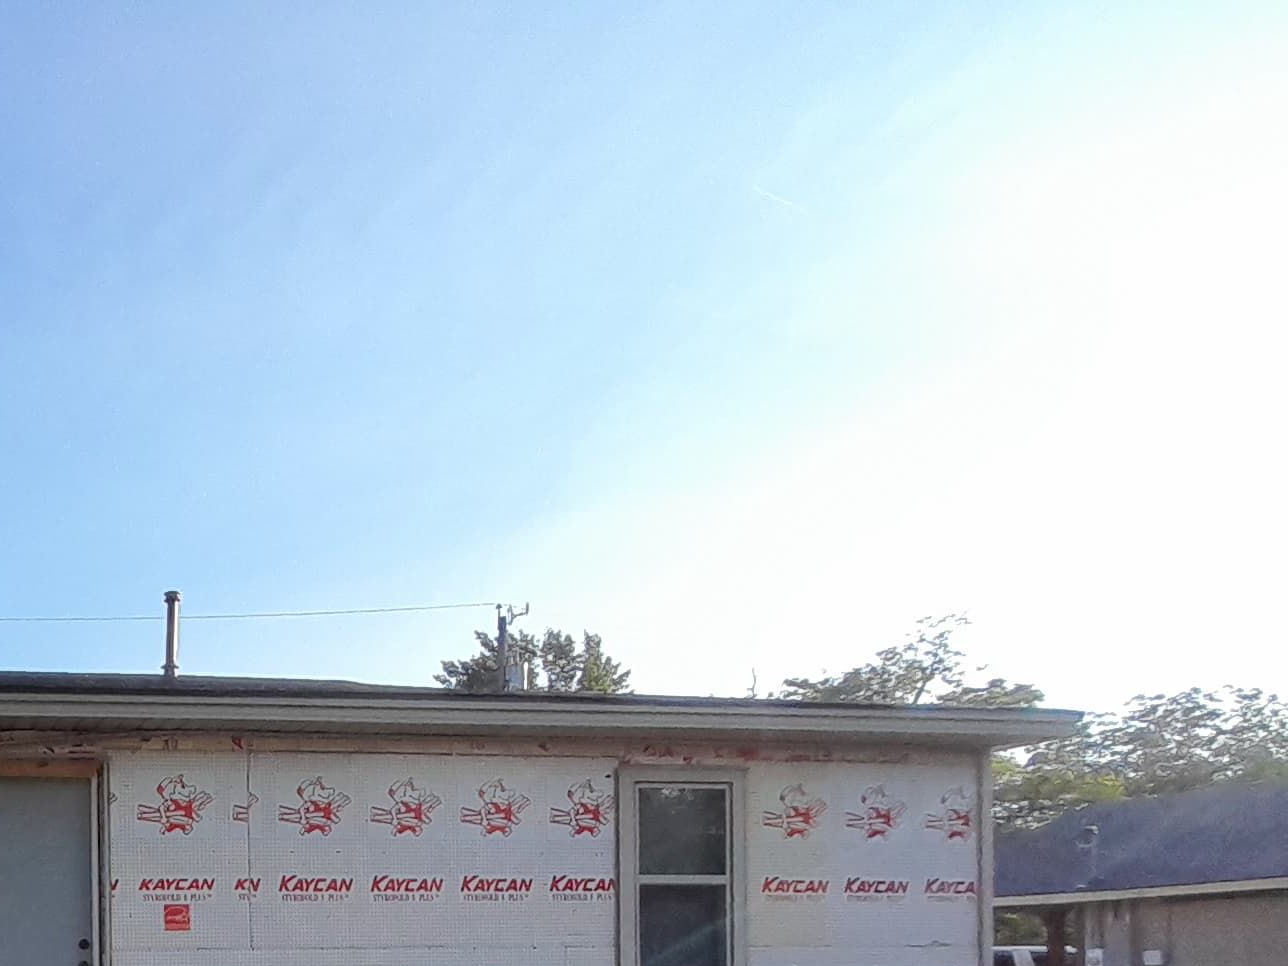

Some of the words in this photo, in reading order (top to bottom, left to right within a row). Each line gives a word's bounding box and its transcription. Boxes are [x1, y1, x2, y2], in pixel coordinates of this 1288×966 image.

[139, 878, 215, 891] KAYCAN
[279, 874, 353, 892] KAYCAN
[371, 875, 443, 892] KAYCAN
[461, 875, 533, 892] KAYCAN
[761, 876, 829, 894] KAYCAN
[844, 876, 911, 894] KAYCAN
